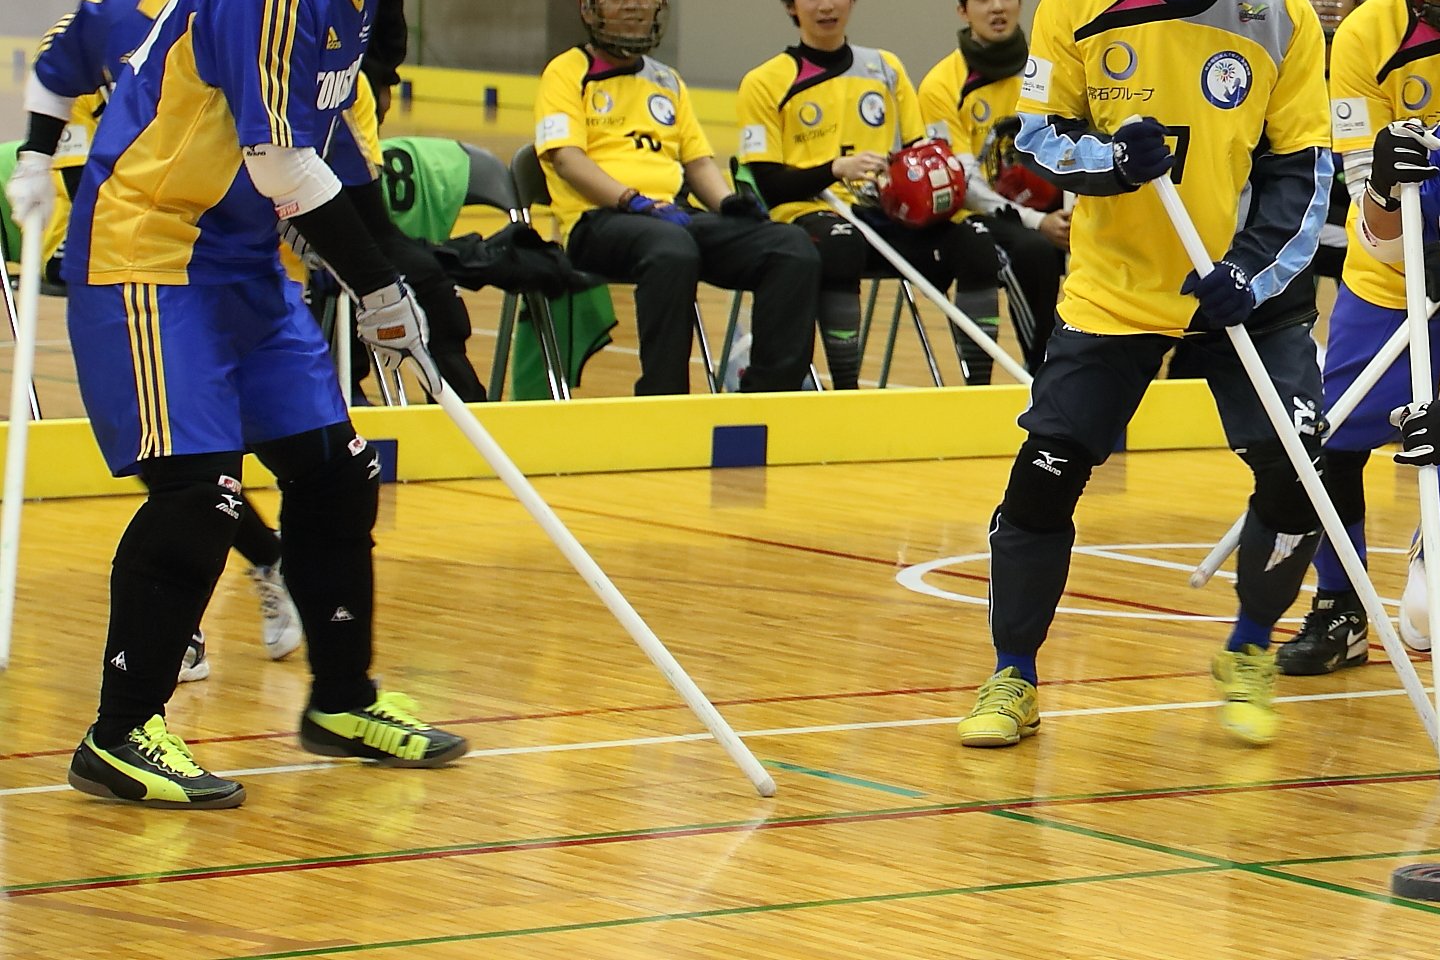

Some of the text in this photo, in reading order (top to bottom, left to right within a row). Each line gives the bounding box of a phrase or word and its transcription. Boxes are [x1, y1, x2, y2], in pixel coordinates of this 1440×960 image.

[382, 148, 415, 212] 8
[1161, 126, 1191, 184] 7
[352, 720, 431, 761] PUMA
